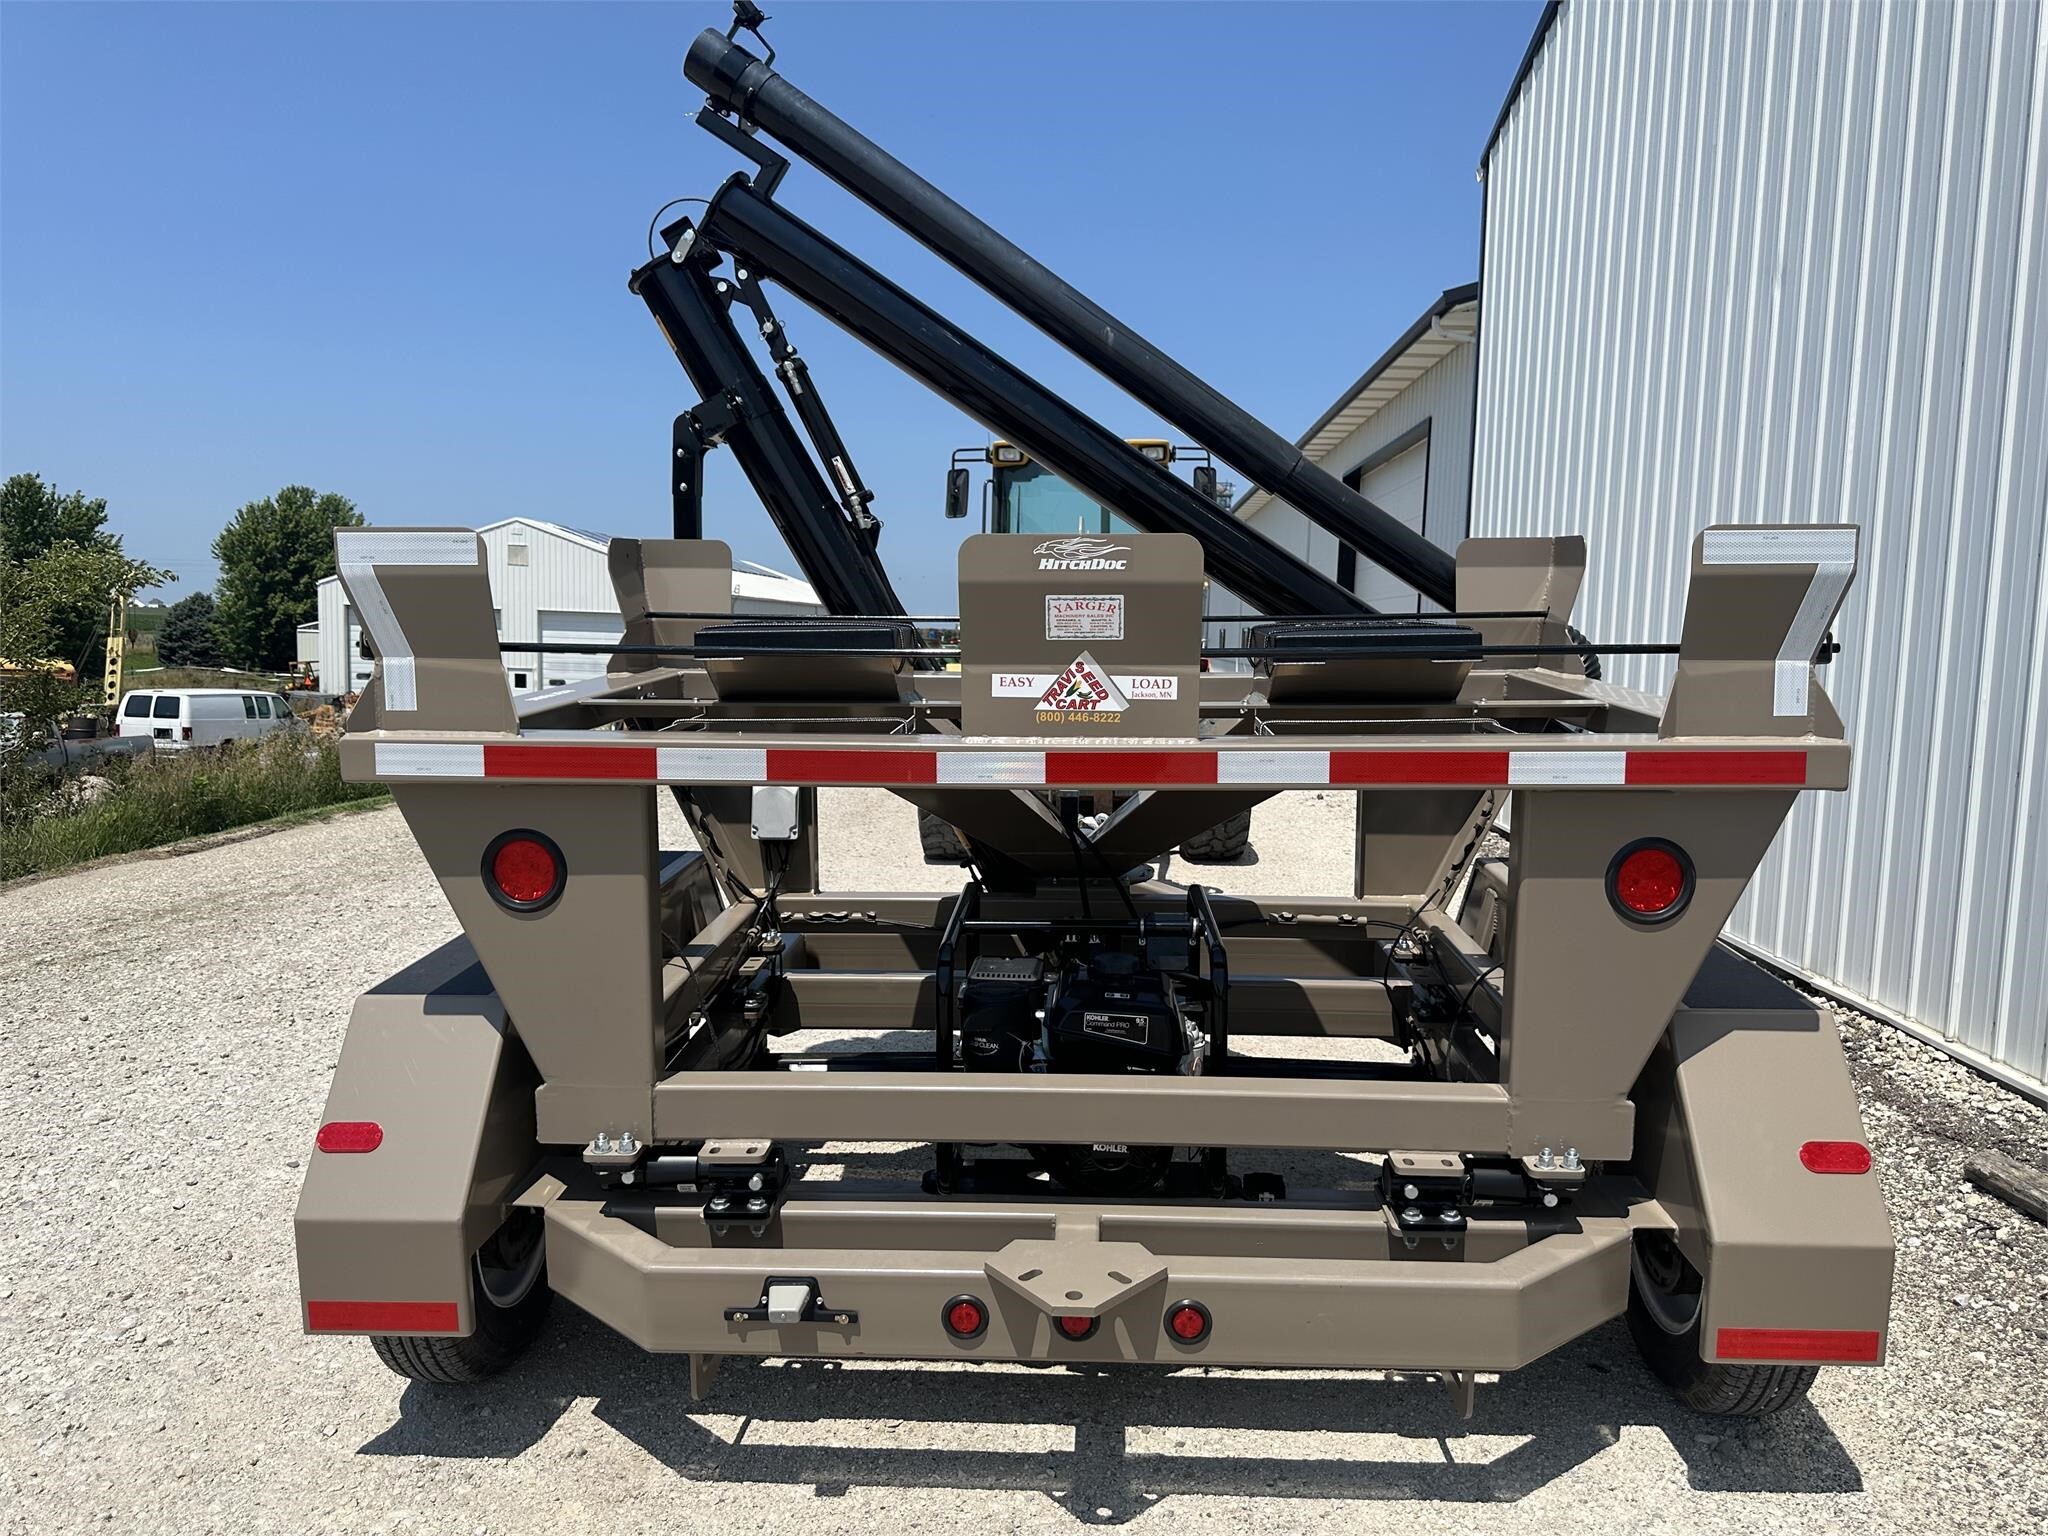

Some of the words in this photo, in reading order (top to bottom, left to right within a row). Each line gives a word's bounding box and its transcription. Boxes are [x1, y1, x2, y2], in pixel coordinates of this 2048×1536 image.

[1052, 601, 1117, 614] YARGER
[999, 676, 1035, 688] EASY
[1132, 678, 1172, 689] LOAD
[1131, 690, 1158, 698] Jackson,
[1055, 698, 1101, 710] CART
[1036, 711, 1064, 723] (800)
[1067, 712, 1121, 723] 446-8222
[1086, 1020, 1116, 1028] Command
[1092, 1143, 1128, 1153] KOHLER
